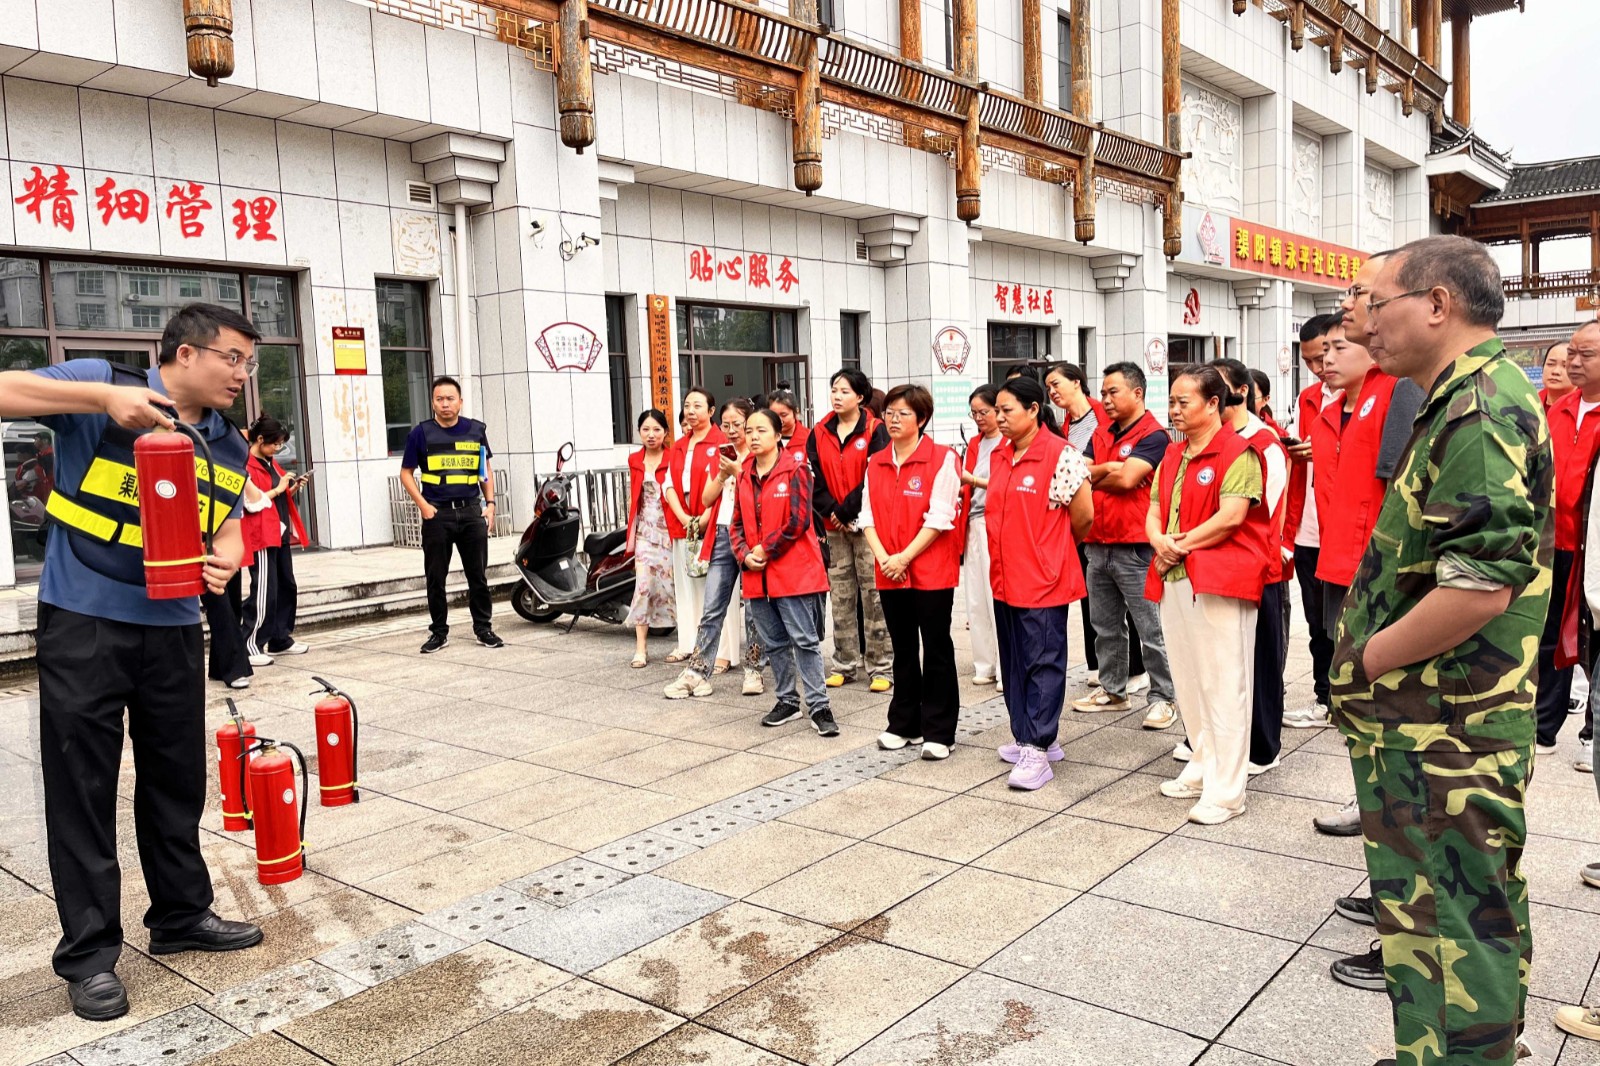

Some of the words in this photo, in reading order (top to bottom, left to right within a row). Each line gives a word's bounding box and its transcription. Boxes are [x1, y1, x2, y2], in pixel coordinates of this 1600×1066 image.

[14, 165, 279, 242] 精细管理
[690, 246, 800, 293] 贴心服务
[994, 283, 1054, 316] 智慧社区
[195, 461, 242, 490] Y6055
